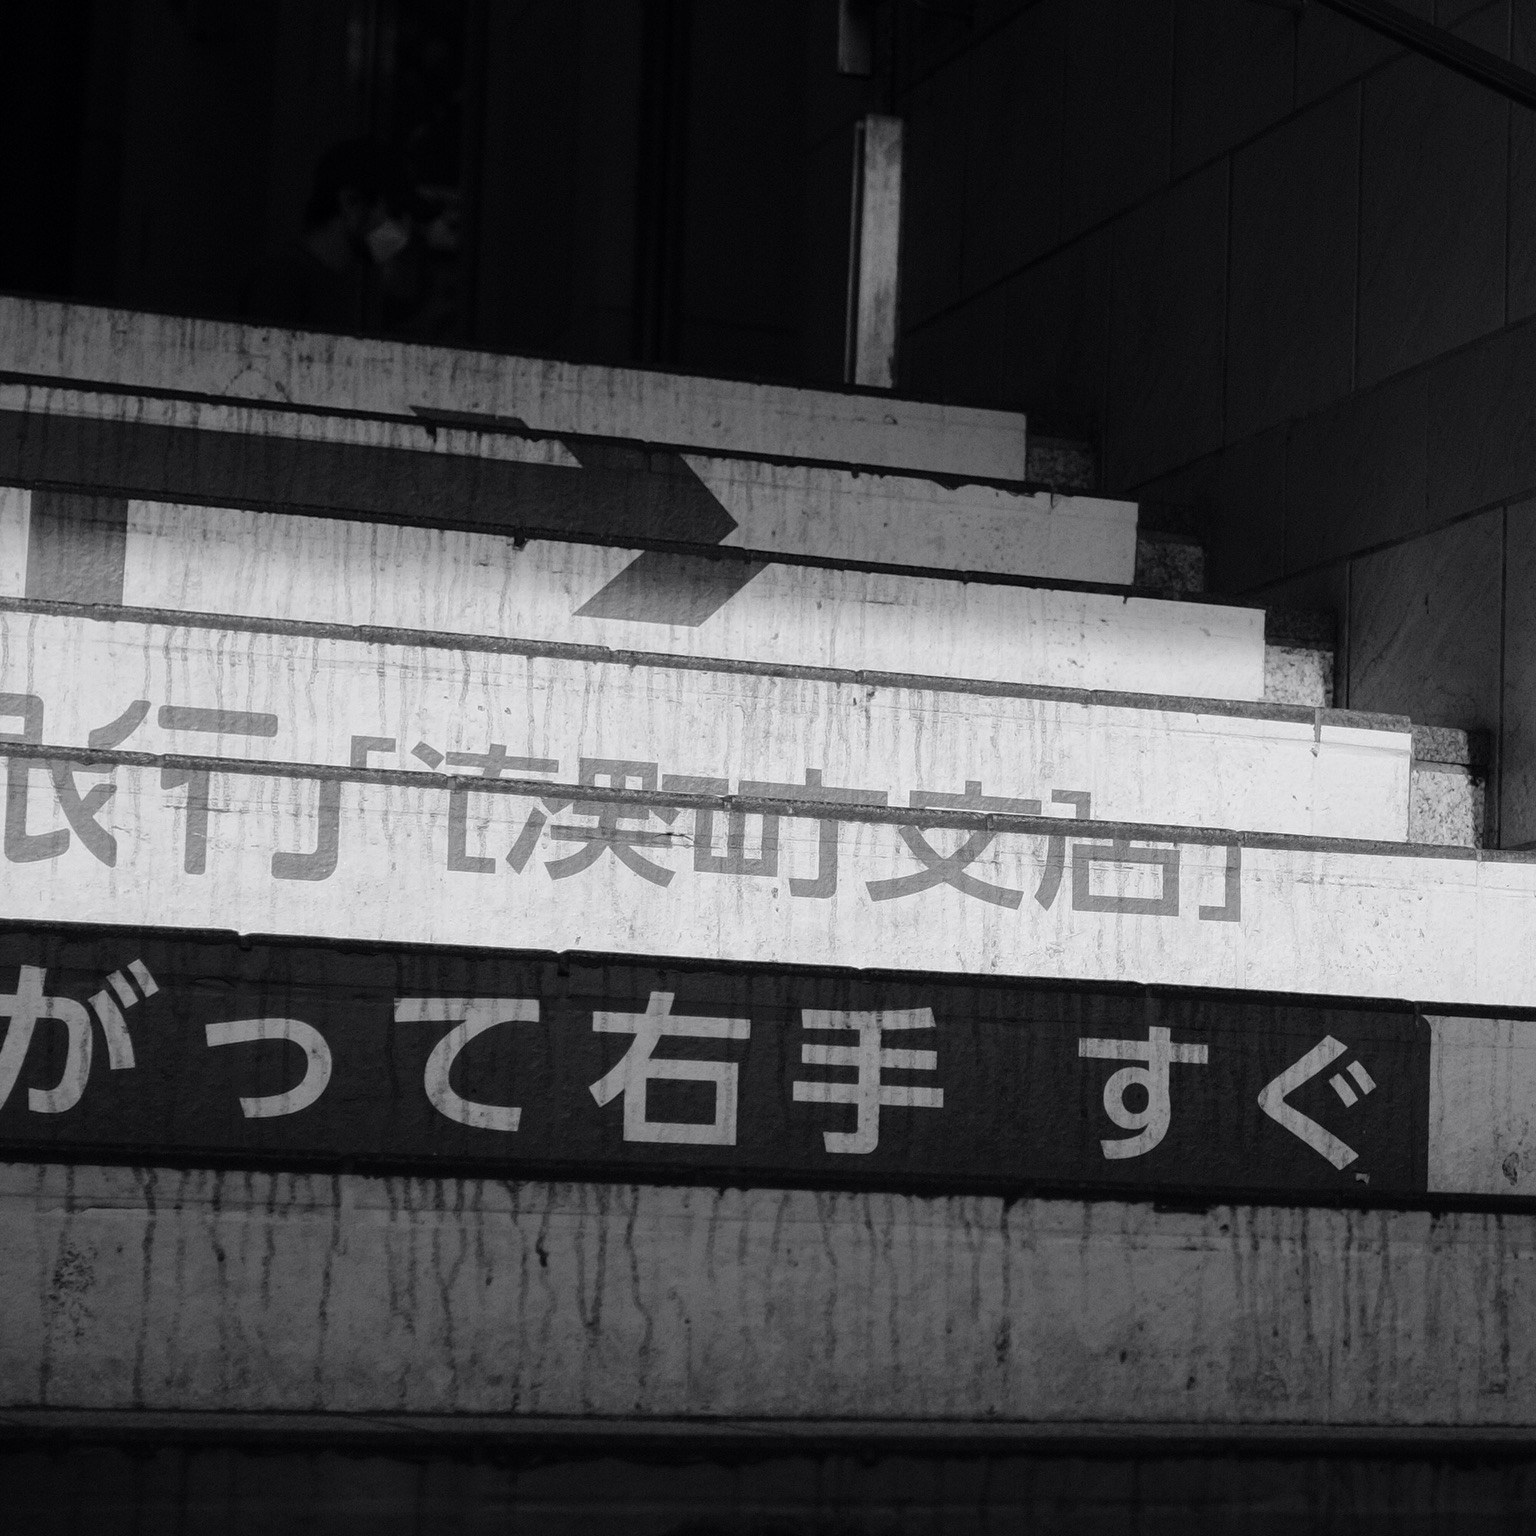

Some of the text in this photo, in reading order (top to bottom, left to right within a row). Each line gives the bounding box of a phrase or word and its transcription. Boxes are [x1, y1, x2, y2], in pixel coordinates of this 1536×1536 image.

[0, 958, 1377, 1171] がって右手 すぐ
